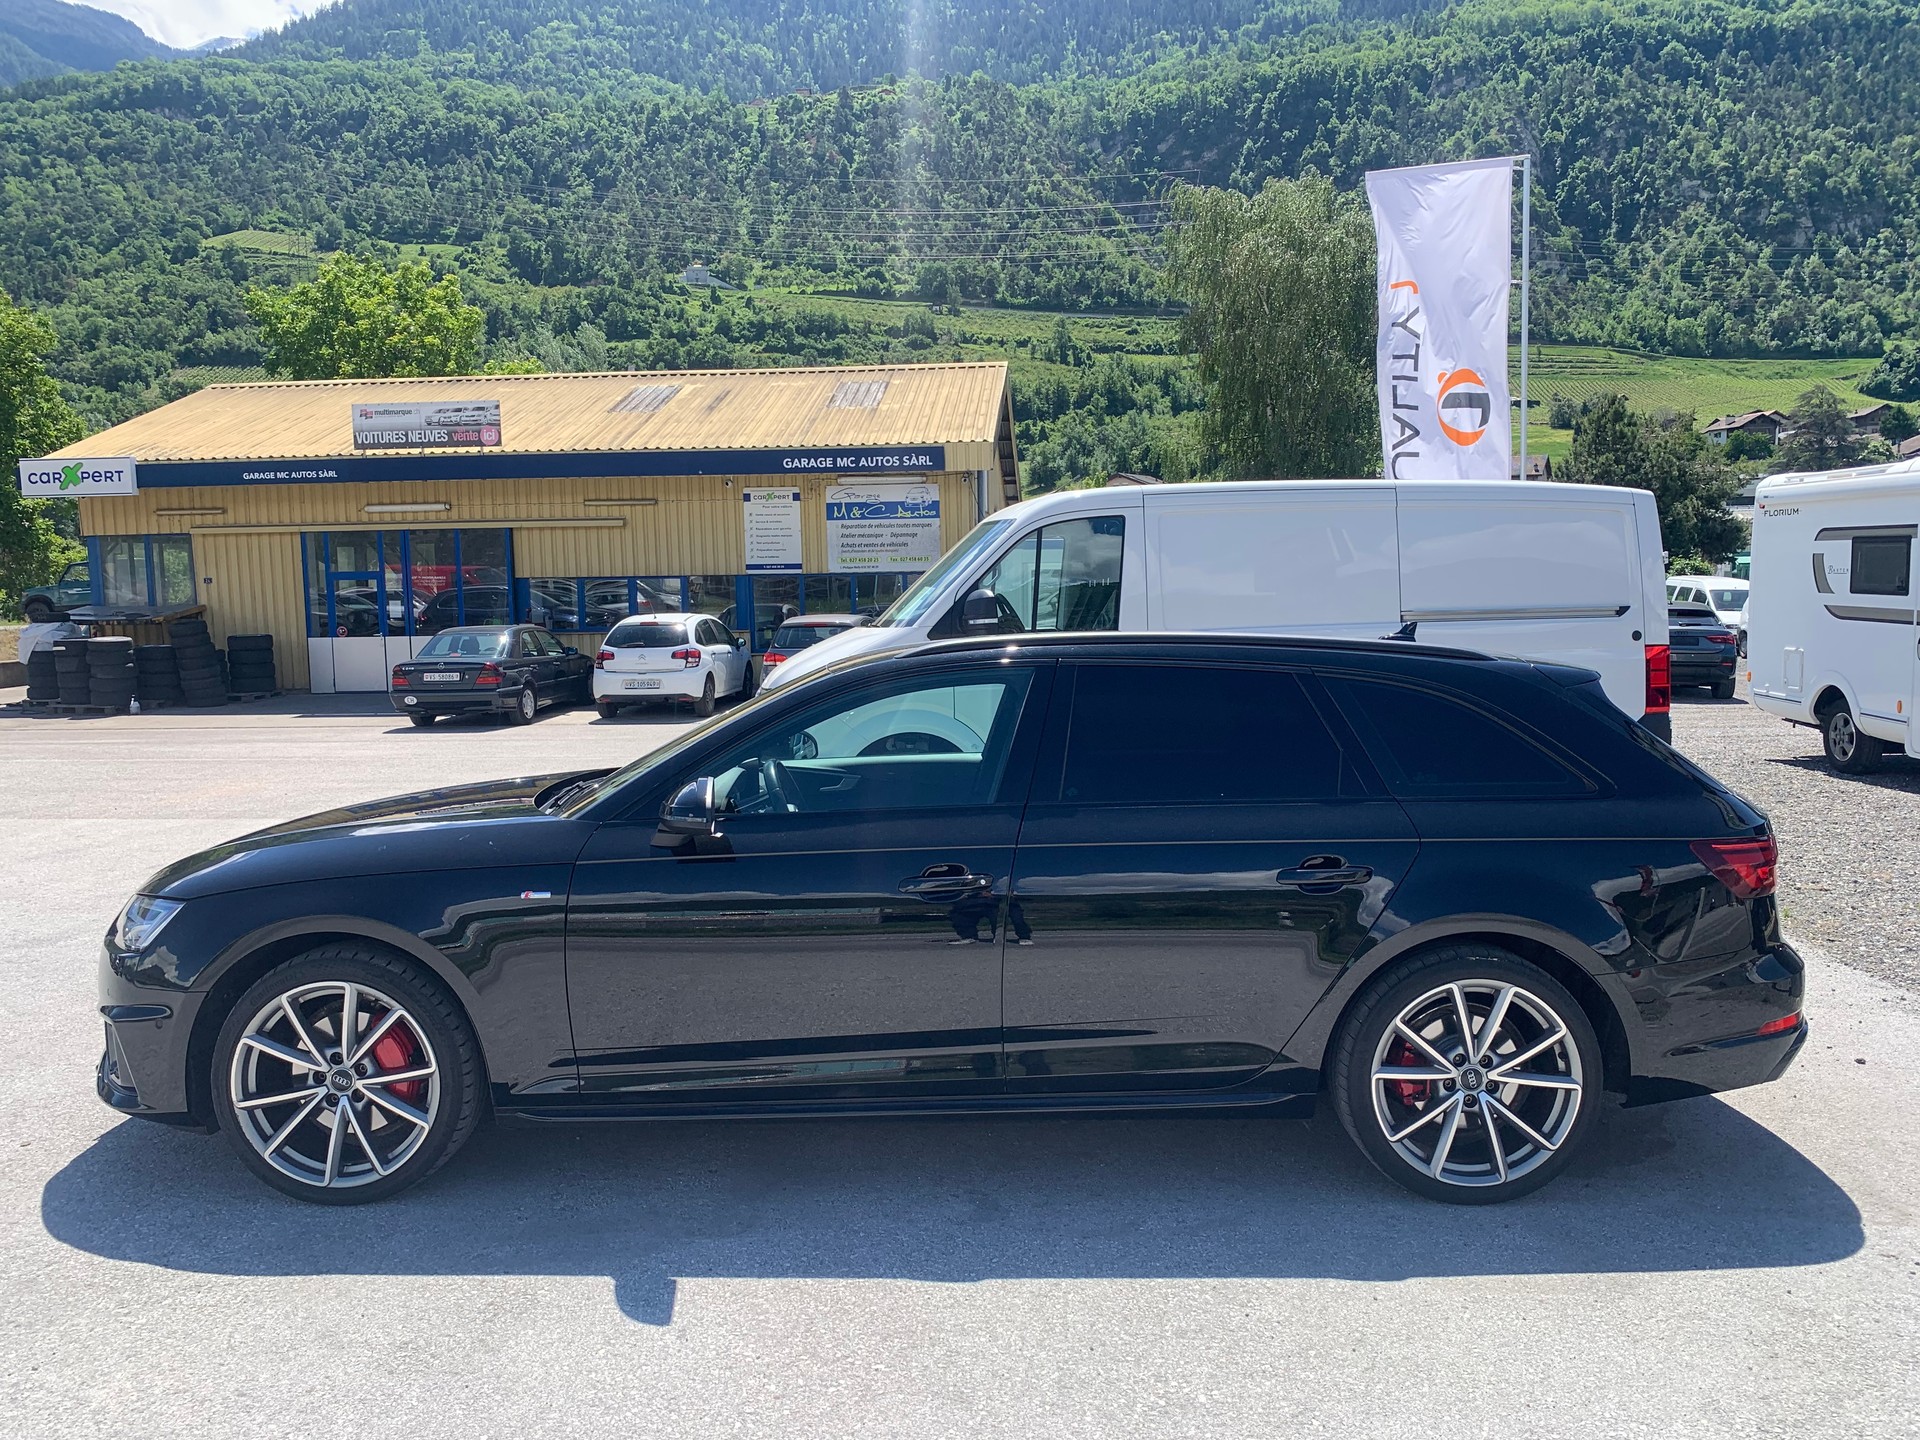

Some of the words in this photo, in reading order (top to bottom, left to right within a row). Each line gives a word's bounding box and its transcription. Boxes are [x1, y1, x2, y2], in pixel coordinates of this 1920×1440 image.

[357, 431, 406, 444] VOITURES
[408, 429, 448, 442] NEUVES
[452, 430, 478, 441] vente
[483, 429, 495, 440] ici
[783, 458, 833, 468] GARAGE
[837, 457, 856, 467] MC
[859, 456, 900, 467] AUTOS
[903, 454, 933, 466] SÀRL
[243, 472, 275, 480] GARAGE
[318, 469, 337, 477] SÀRL
[831, 487, 880, 504] Garage
[834, 501, 848, 519] M
[850, 506, 865, 518] &
[865, 505, 890, 517] C
[890, 504, 936, 518] Autos
[1764, 508, 1799, 517] FLORIUM
